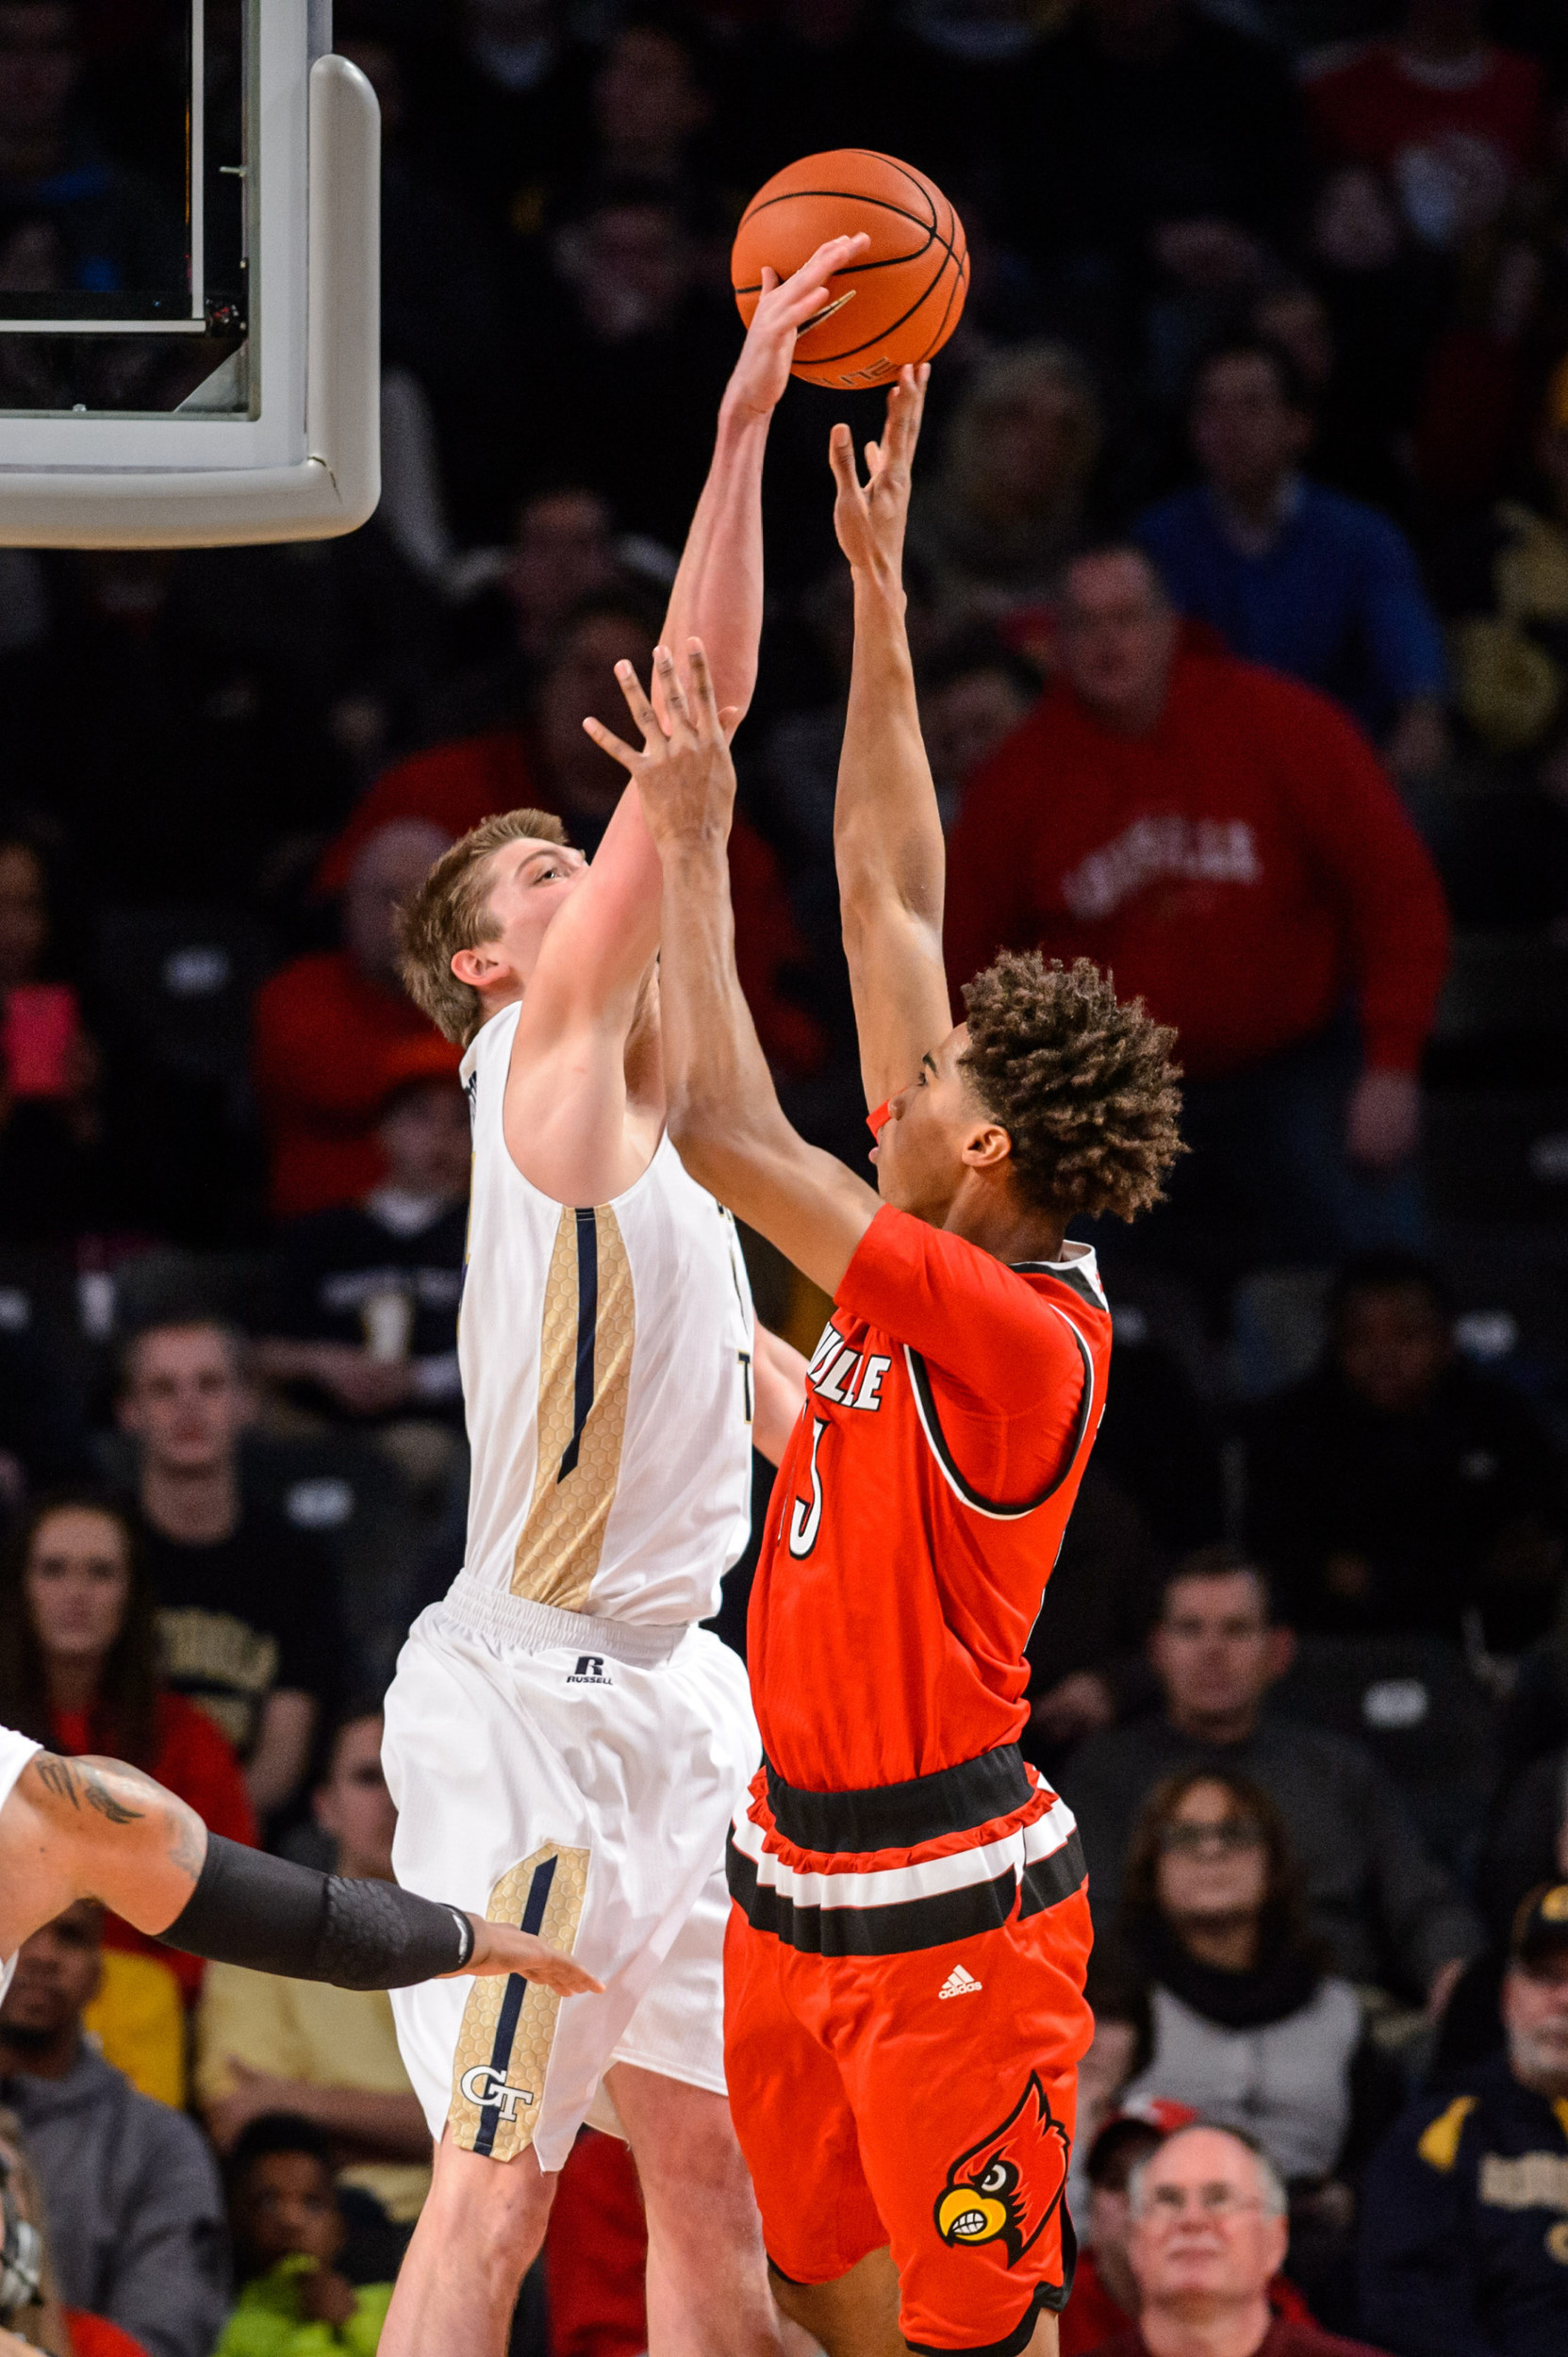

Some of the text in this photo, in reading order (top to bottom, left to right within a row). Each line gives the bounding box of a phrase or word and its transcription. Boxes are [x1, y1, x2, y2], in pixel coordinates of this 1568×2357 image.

[566, 1675, 614, 1686] RUSSELL
[938, 1981, 983, 2000] adidas
[460, 2065, 534, 2122] GT
